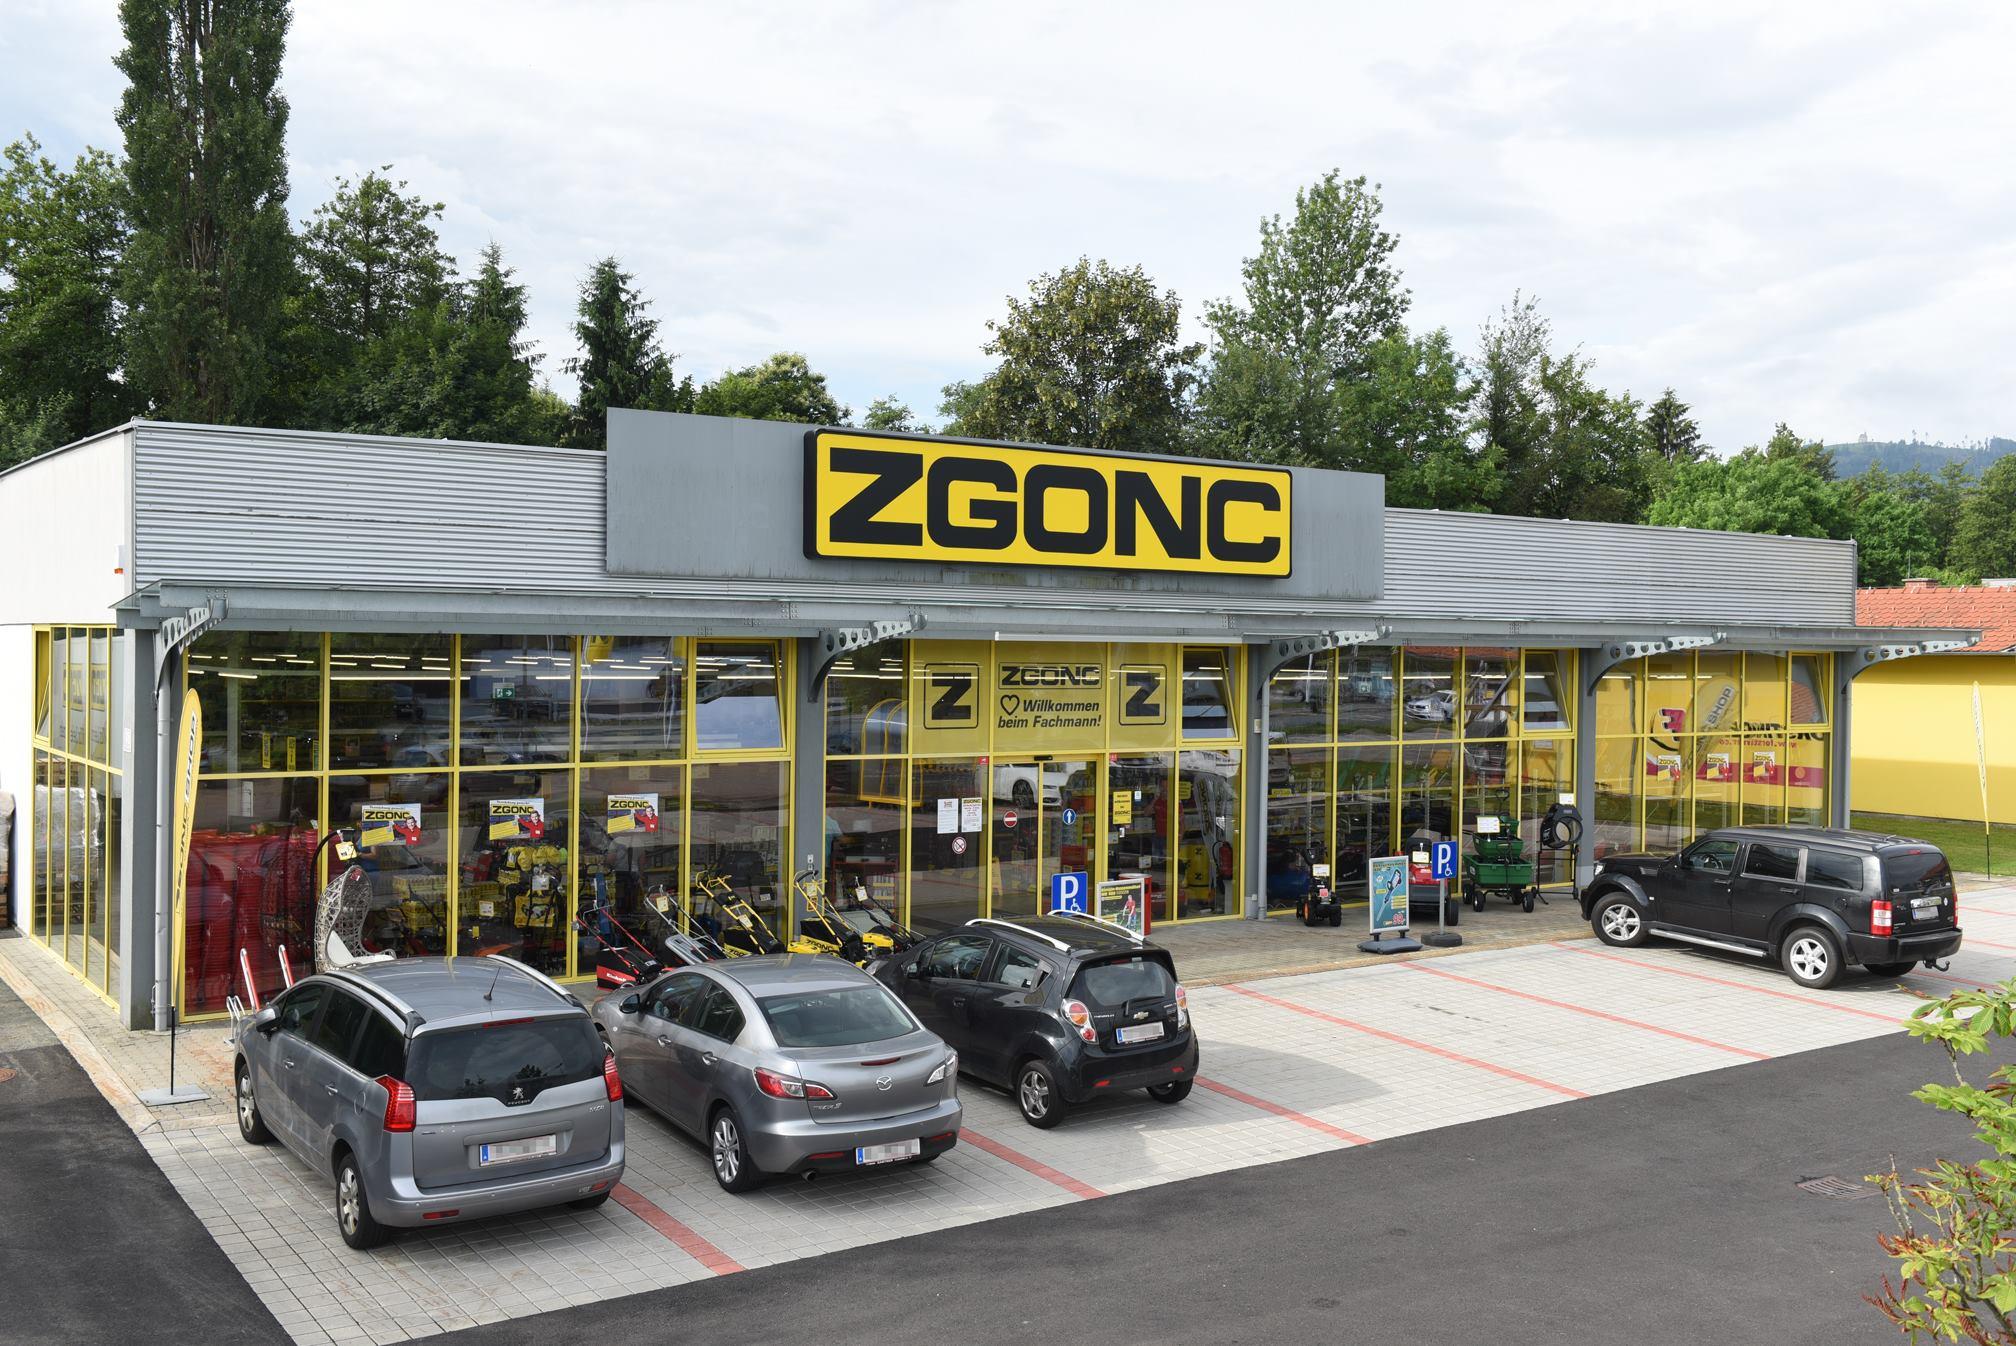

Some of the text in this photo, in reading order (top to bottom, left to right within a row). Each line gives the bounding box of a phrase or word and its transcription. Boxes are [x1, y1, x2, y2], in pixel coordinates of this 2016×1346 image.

[829, 447, 1281, 563] ZGONC
[1001, 666, 1100, 686] ZGONC
[931, 672, 972, 720] Z
[1022, 699, 1100, 713] Willkommen
[1126, 672, 1161, 717] Z
[1707, 687, 1732, 725] SHOP
[997, 714, 1102, 729] beim Fachmann!
[364, 811, 410, 820] ZGONC
[492, 805, 534, 814] ZGONC
[610, 800, 650, 809] ZGONC
[1438, 844, 1452, 875] P
[1060, 875, 1079, 911] P
